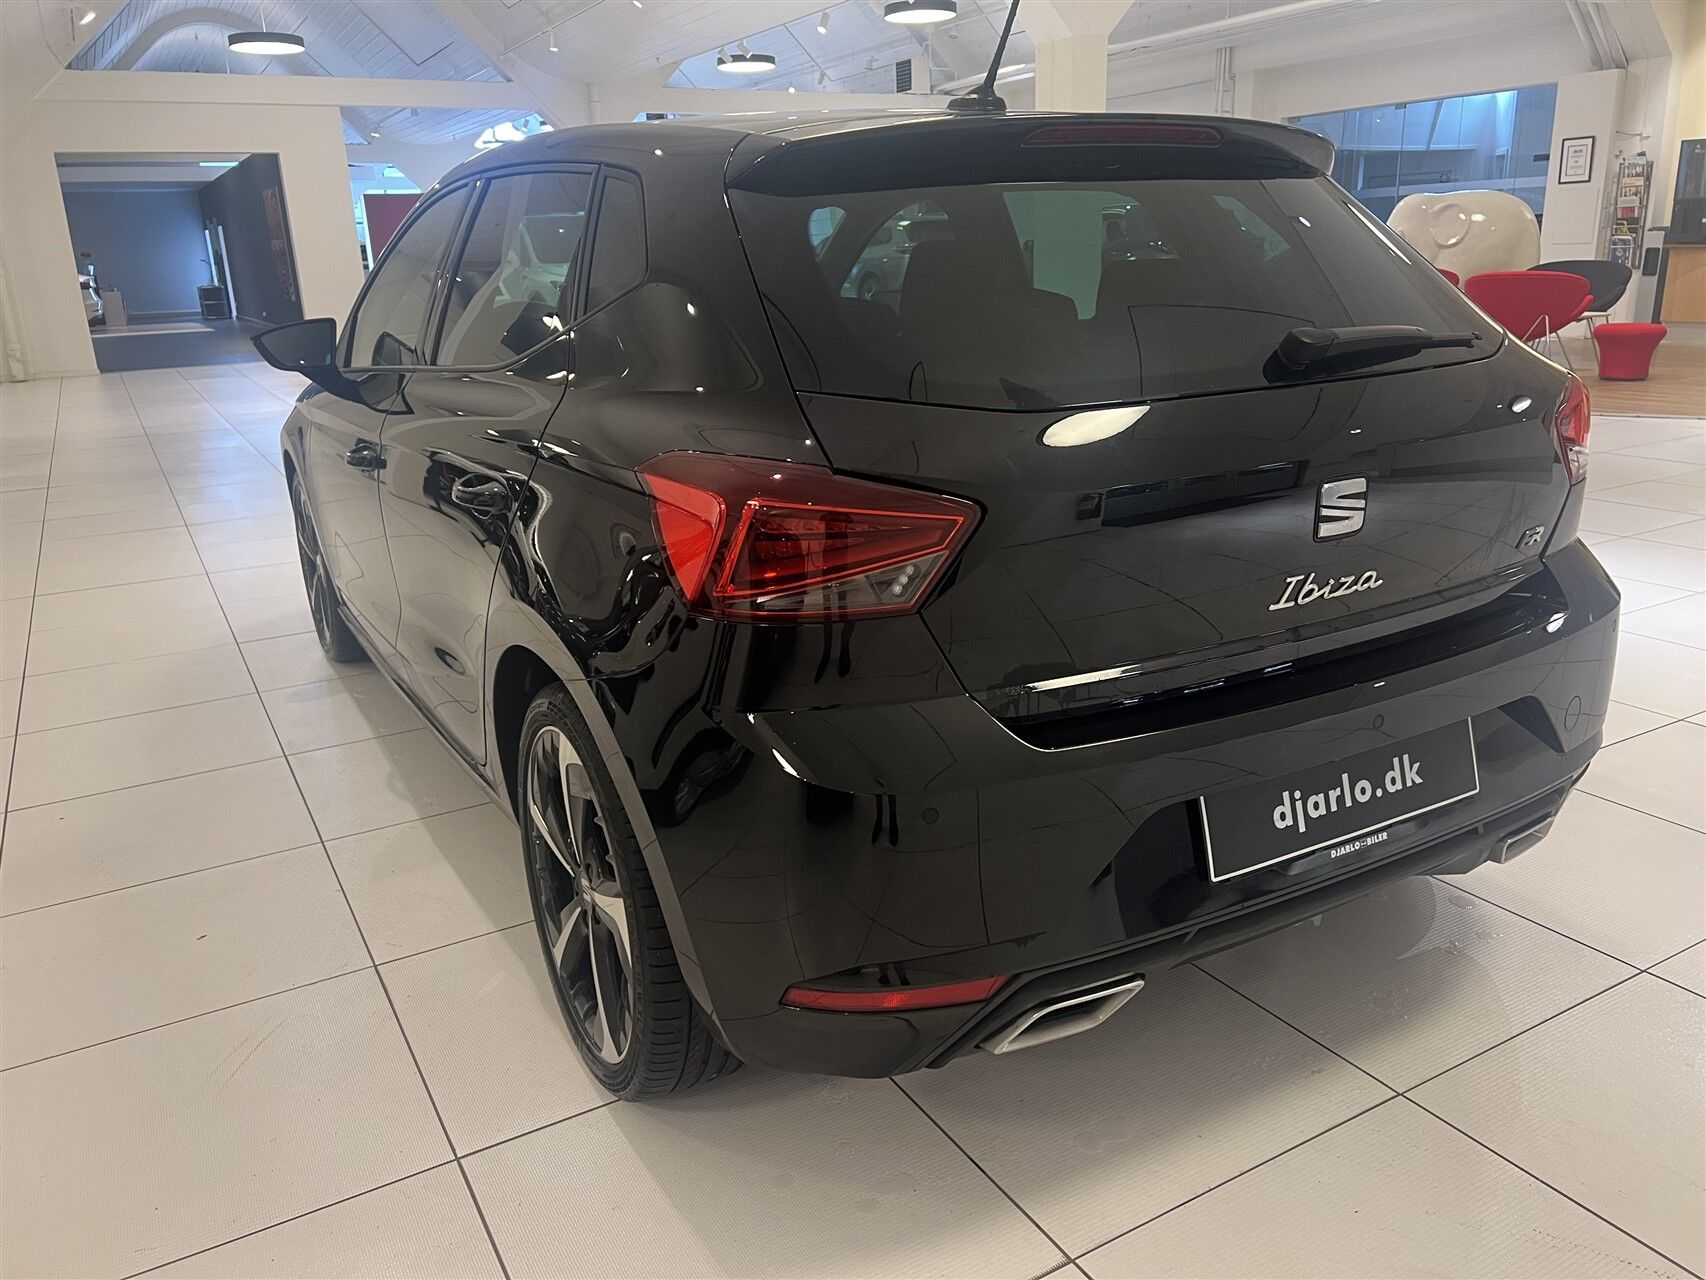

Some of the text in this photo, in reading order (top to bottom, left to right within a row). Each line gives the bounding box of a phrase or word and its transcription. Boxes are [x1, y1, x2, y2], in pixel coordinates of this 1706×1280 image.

[1268, 569, 1384, 611] Ibiza
[1272, 753, 1424, 833] djarlo.dk
[1330, 831, 1388, 859] DJARLO BILER
